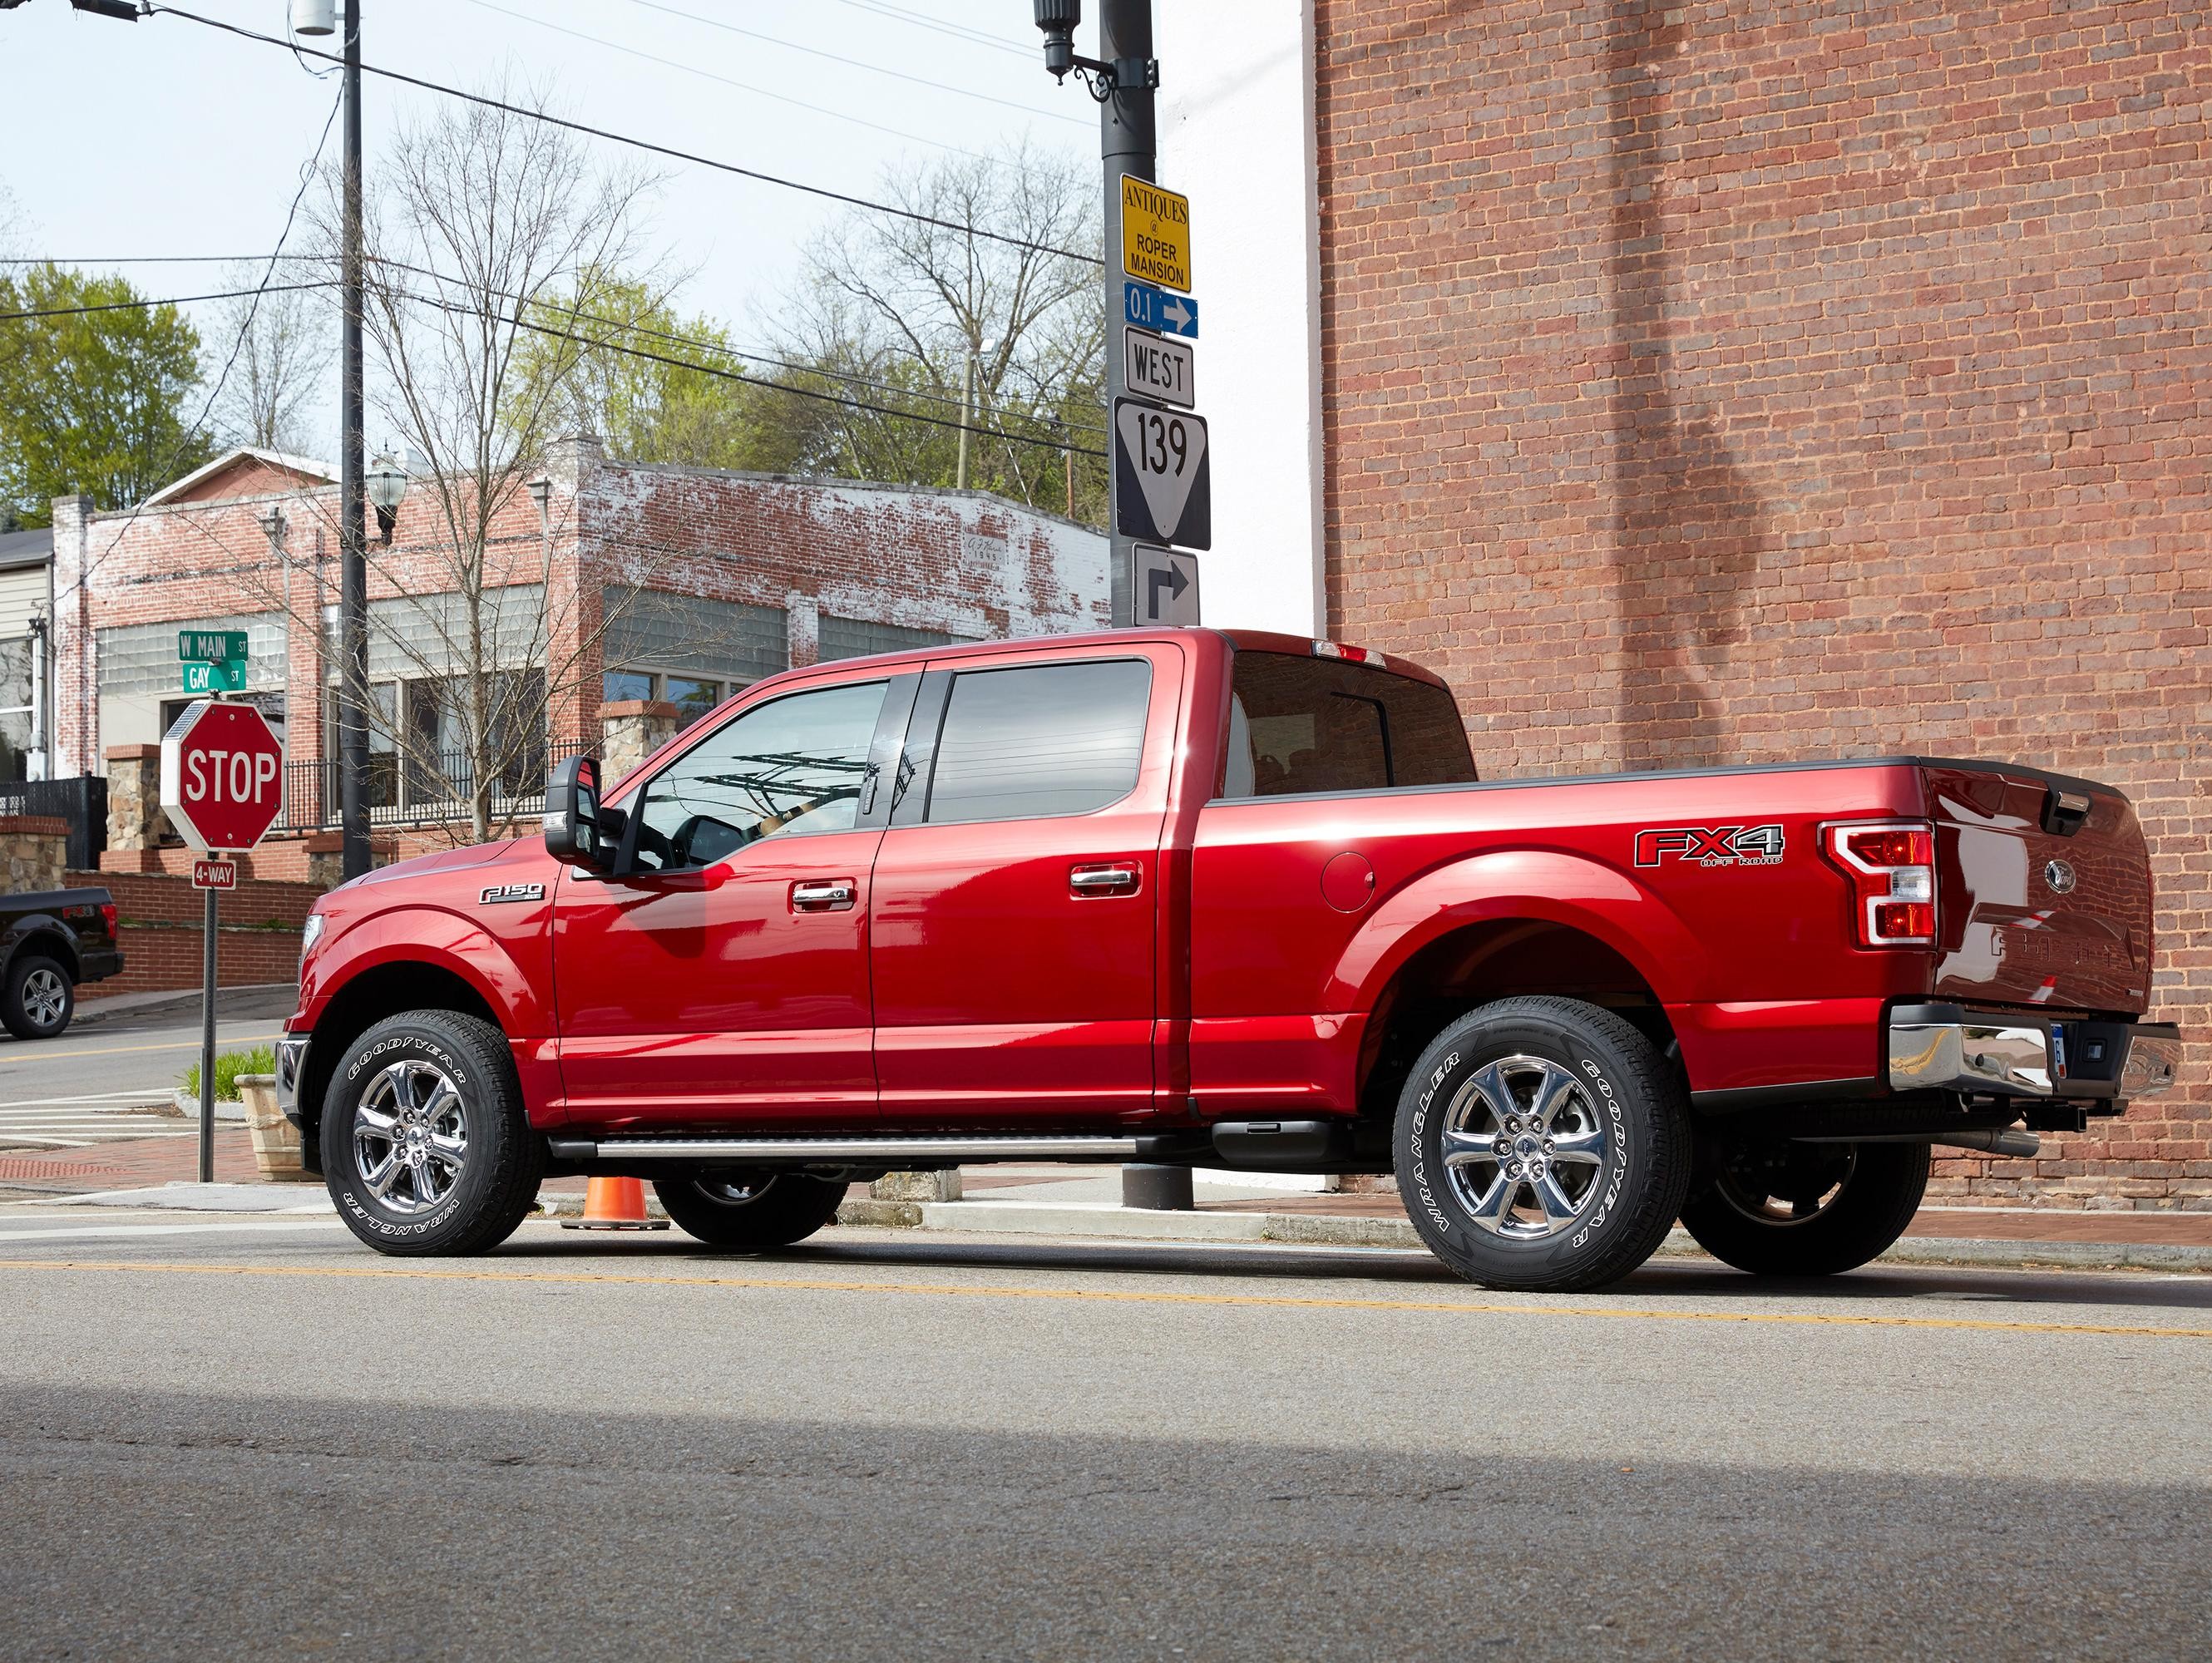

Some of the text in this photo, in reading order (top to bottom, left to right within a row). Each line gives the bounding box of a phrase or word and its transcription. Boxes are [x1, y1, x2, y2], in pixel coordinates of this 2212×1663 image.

[1124, 184, 1187, 225] ANTIQUES
[1137, 234, 1178, 262] ROPER
[1150, 220, 1158, 236] @
[1131, 252, 1184, 285] MANSION
[1130, 287, 1151, 323] 0.1
[1133, 343, 1184, 392] WEST
[1138, 412, 1187, 477] 139
[180, 634, 247, 657] W MAIN ST
[189, 667, 239, 689] GAY ST
[185, 748, 276, 804] STOP
[1634, 824, 1785, 867] FX4
[1701, 857, 1784, 867] OFF ROAD
[196, 866, 233, 883] 4-WAY
[348, 1037, 467, 1084] GOODYEAR
[1411, 1052, 1460, 1233] WRANGLER
[1573, 1059, 1627, 1248] GOODYEAR
[343, 1191, 461, 1236] WRANGLER
